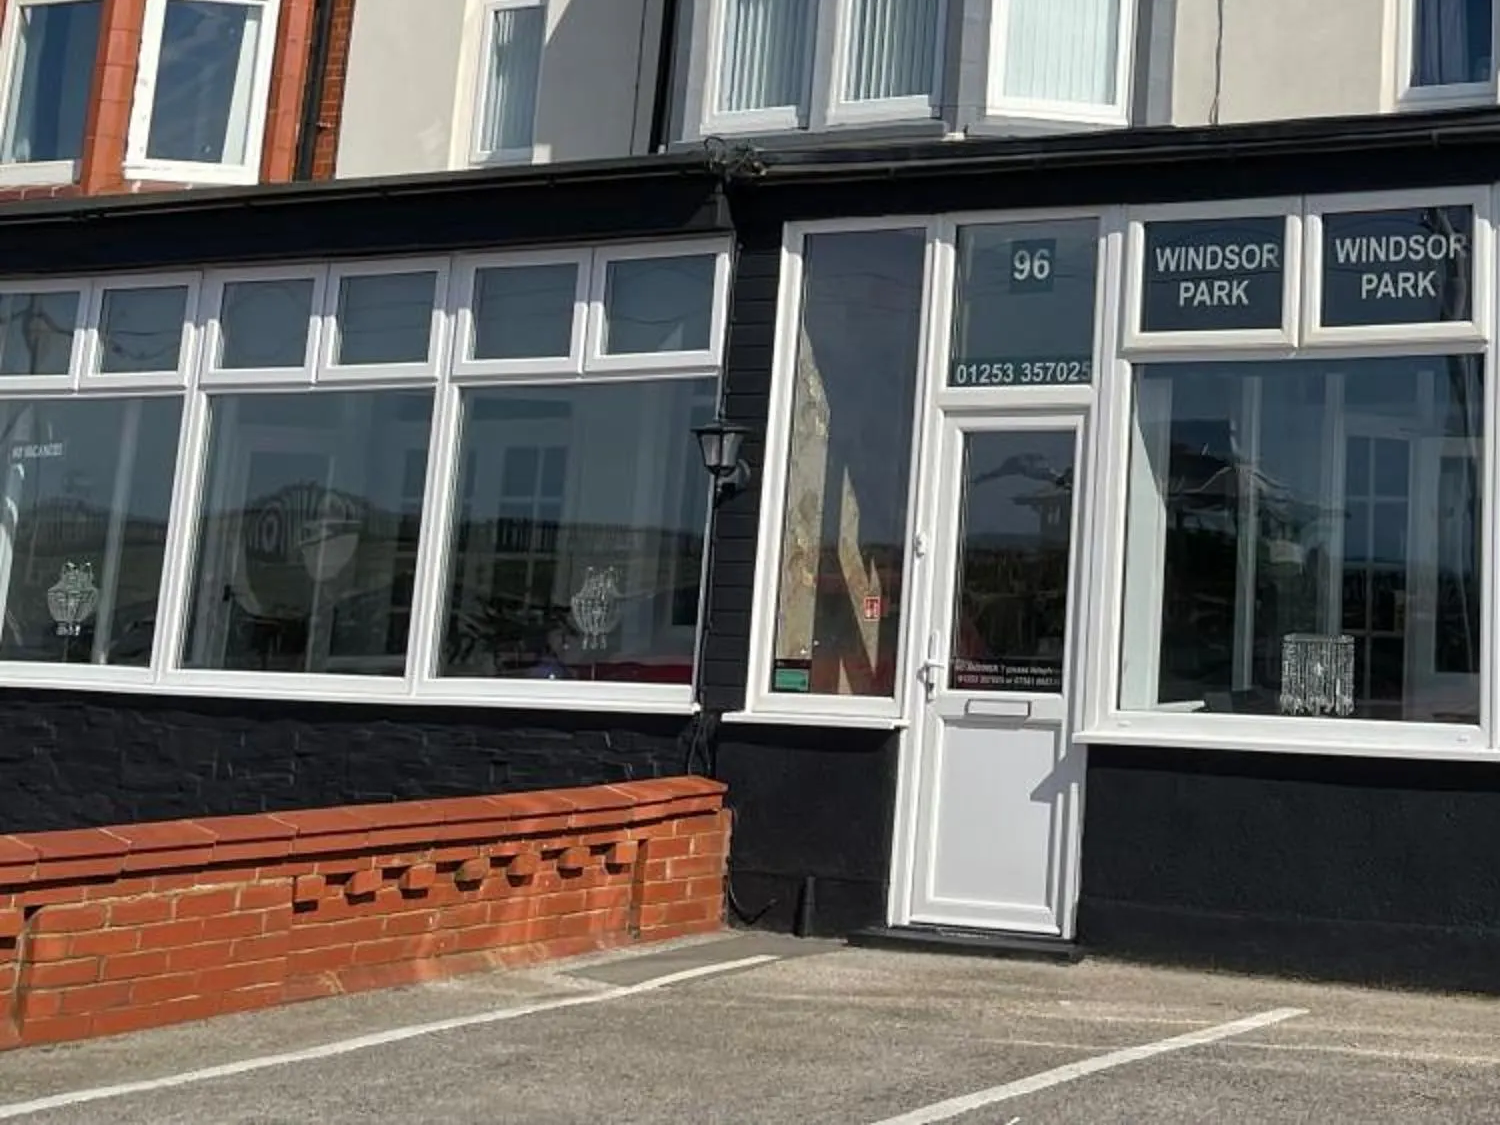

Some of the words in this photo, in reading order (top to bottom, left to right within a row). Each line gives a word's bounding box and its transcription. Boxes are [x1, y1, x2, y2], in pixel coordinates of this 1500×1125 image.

[1156, 243, 1280, 272] WINDSOR
[1335, 233, 1466, 263] WINDSOR
[1013, 249, 1050, 280] 96
[1179, 280, 1249, 307] PARK
[1361, 270, 1437, 299] PARK
[956, 362, 1014, 384] 01253
